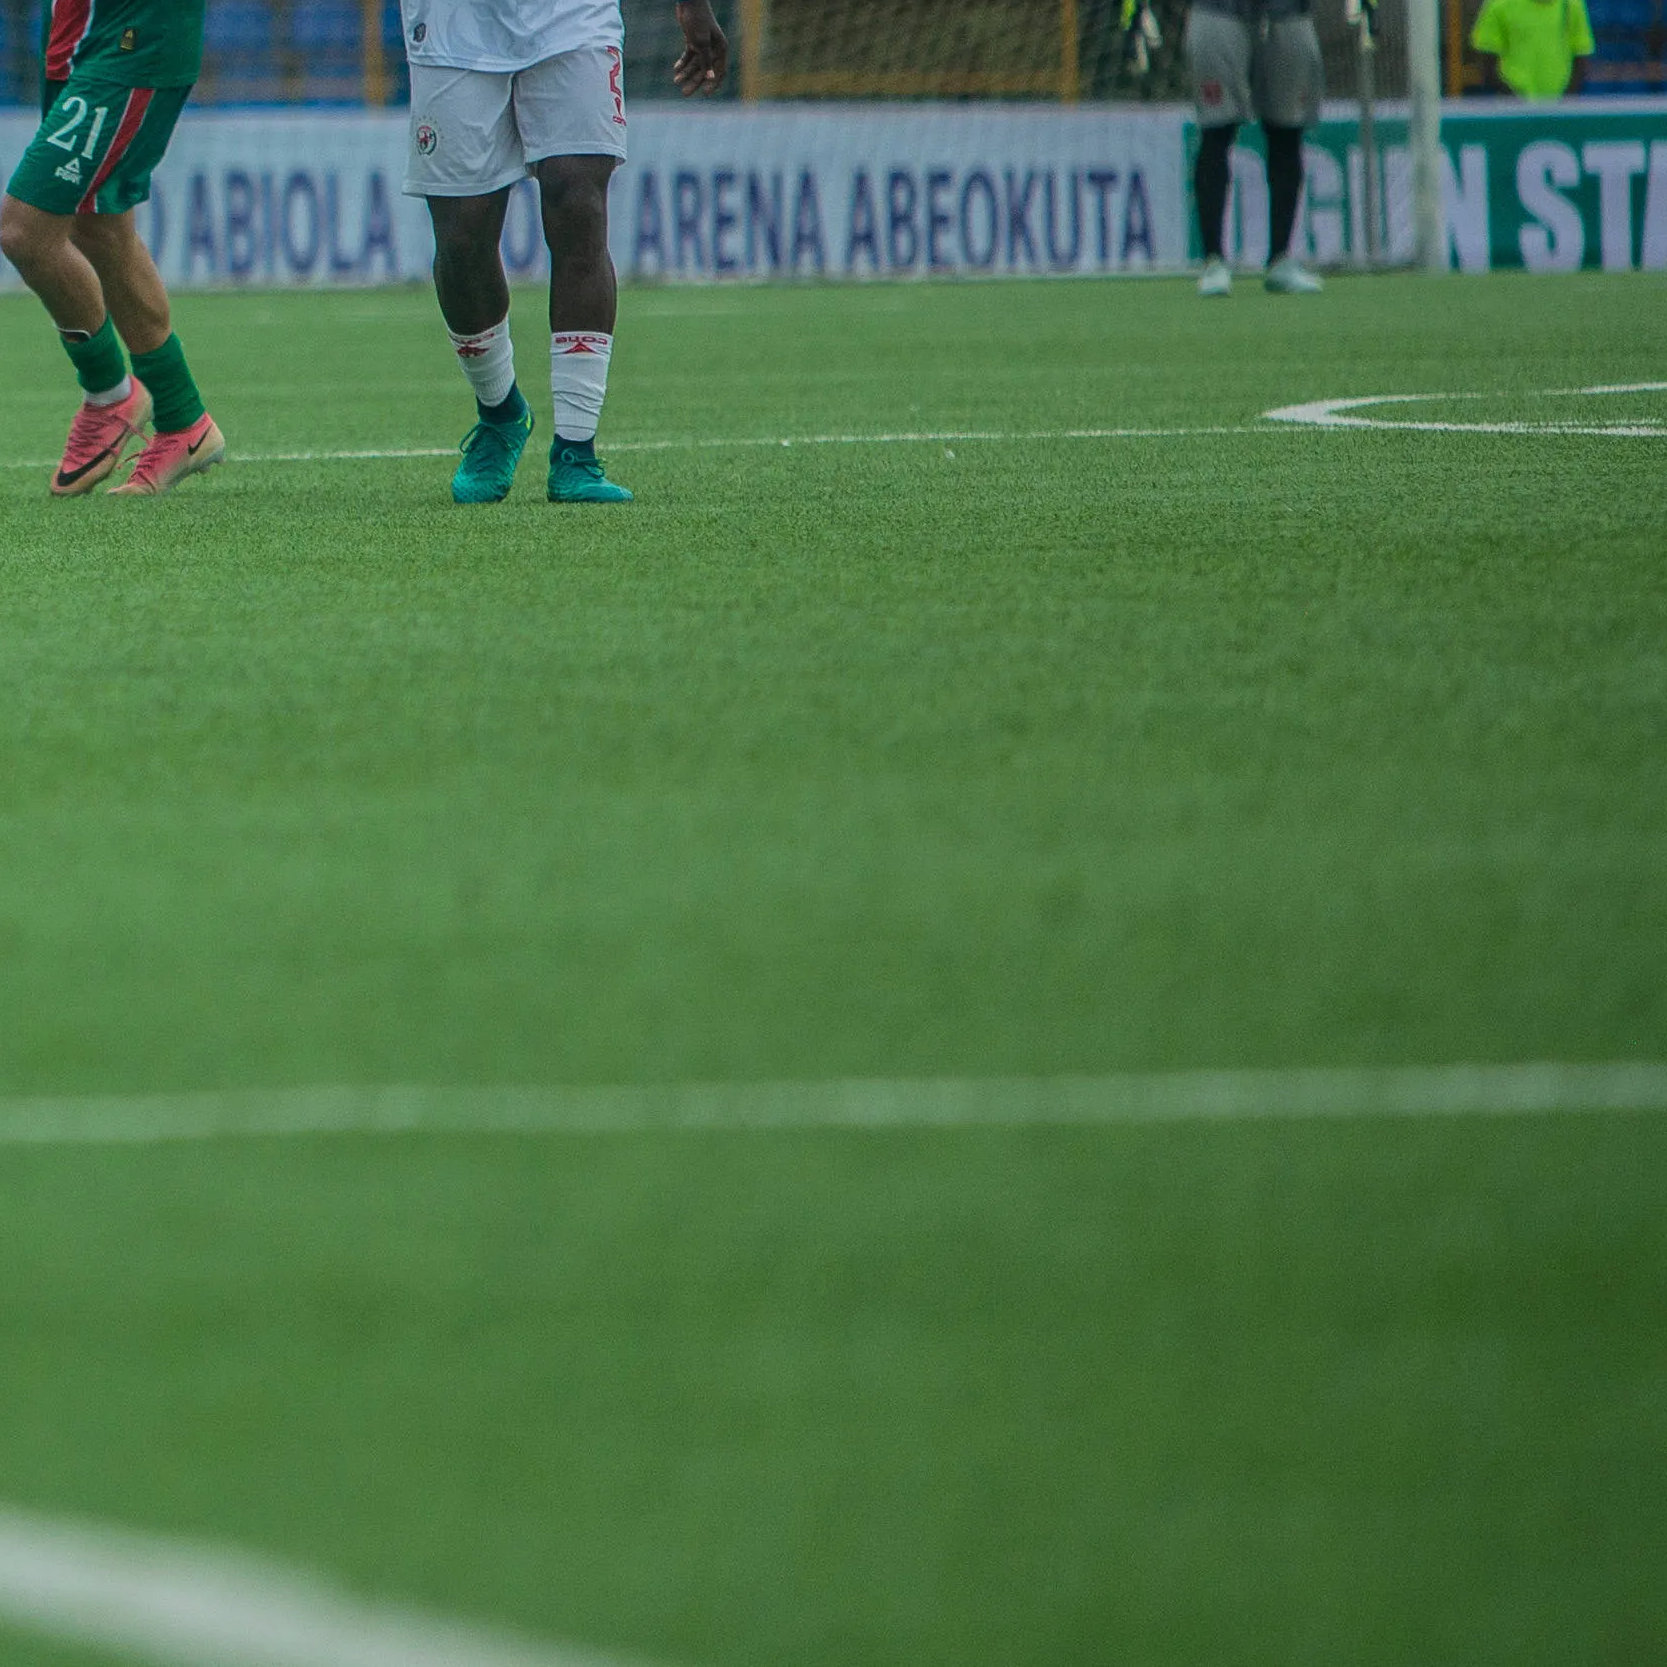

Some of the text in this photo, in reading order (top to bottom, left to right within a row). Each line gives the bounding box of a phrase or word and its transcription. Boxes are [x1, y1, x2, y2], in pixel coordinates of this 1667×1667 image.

[47, 96, 108, 160] 21
[182, 169, 397, 274] ABIOLA
[632, 166, 827, 276] ARENA
[845, 164, 1157, 271] ABEOKUTA
